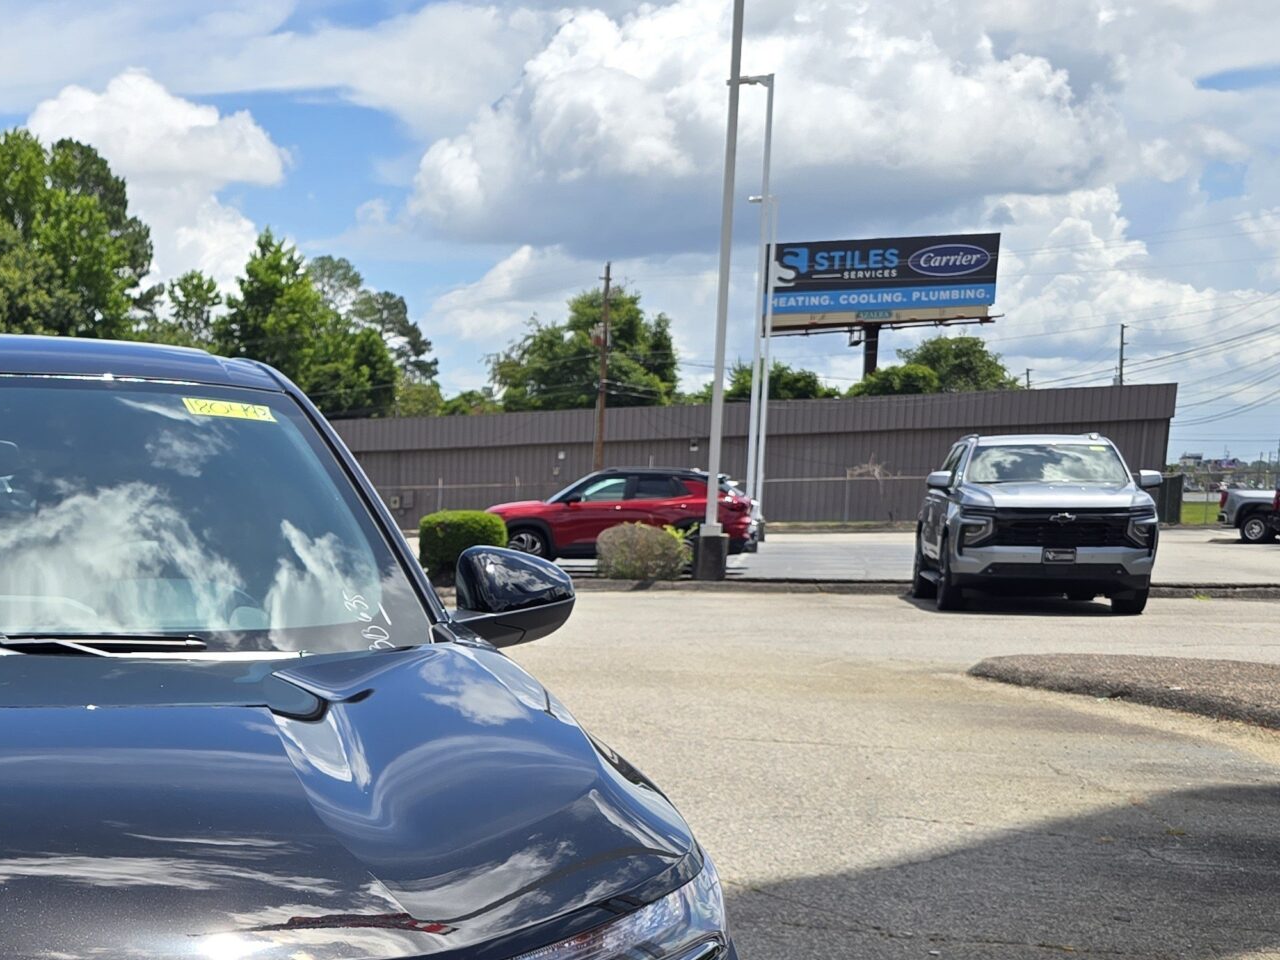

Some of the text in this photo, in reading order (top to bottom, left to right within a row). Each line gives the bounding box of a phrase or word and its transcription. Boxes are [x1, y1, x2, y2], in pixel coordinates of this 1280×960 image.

[814, 248, 899, 271] STILES
[919, 250, 981, 268] Carrier
[842, 268, 898, 280] SERVICES
[839, 291, 907, 305] COOLING.
[912, 287, 991, 302] PLUMBING.
